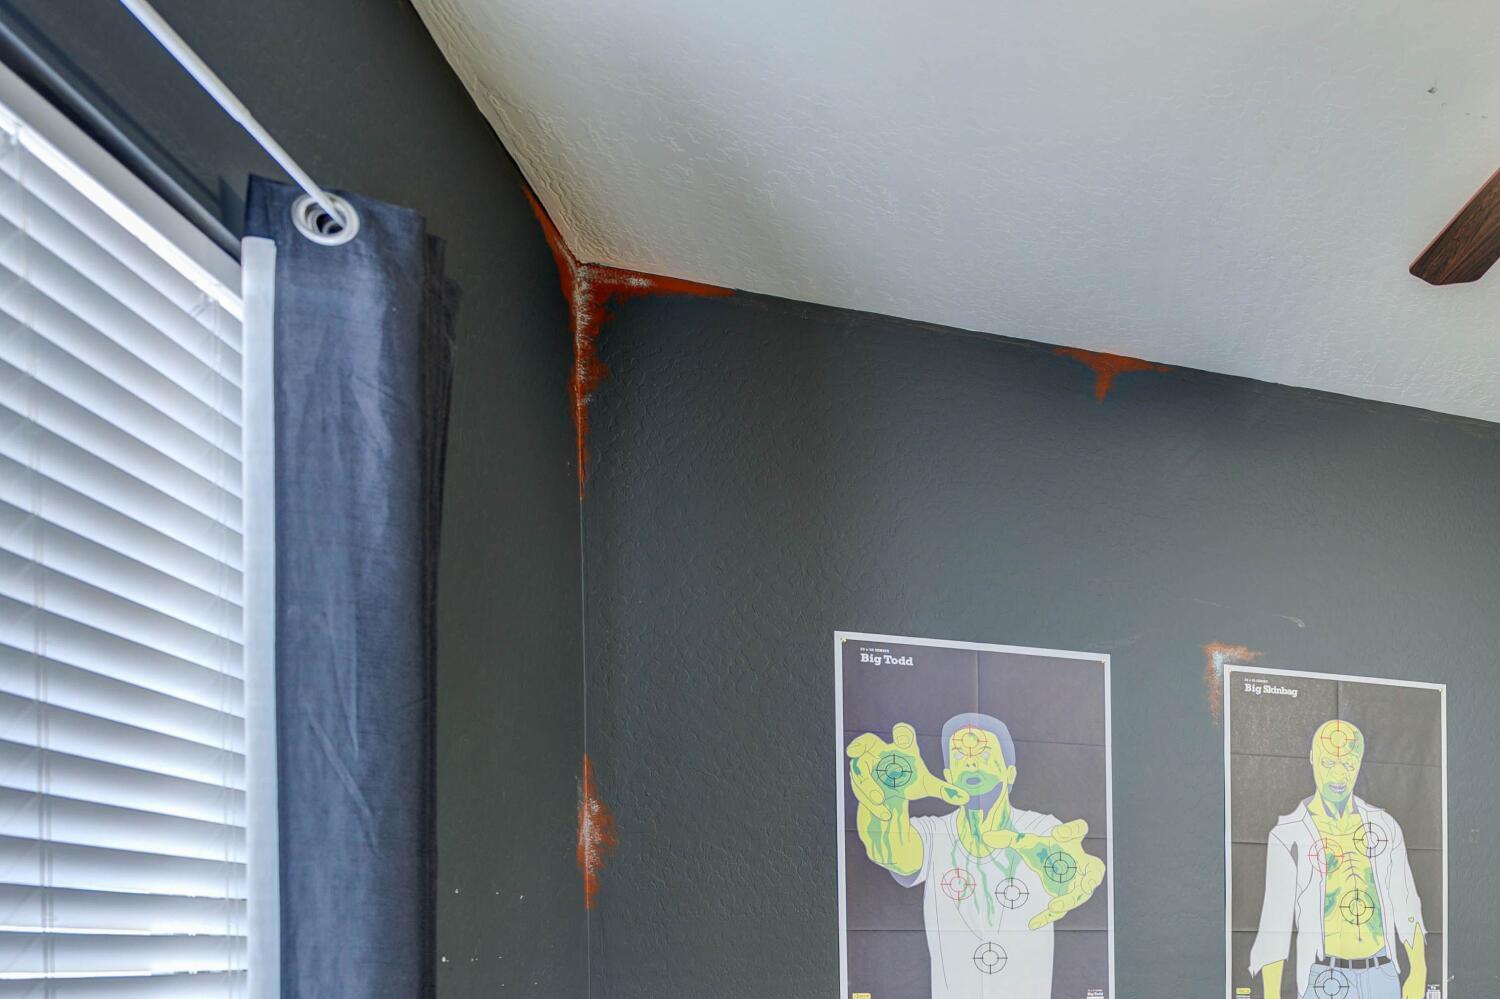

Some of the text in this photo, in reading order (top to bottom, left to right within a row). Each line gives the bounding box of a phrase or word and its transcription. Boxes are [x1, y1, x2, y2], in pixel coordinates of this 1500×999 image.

[860, 652, 914, 666] Big Todd
[1244, 683, 1262, 695] Big
